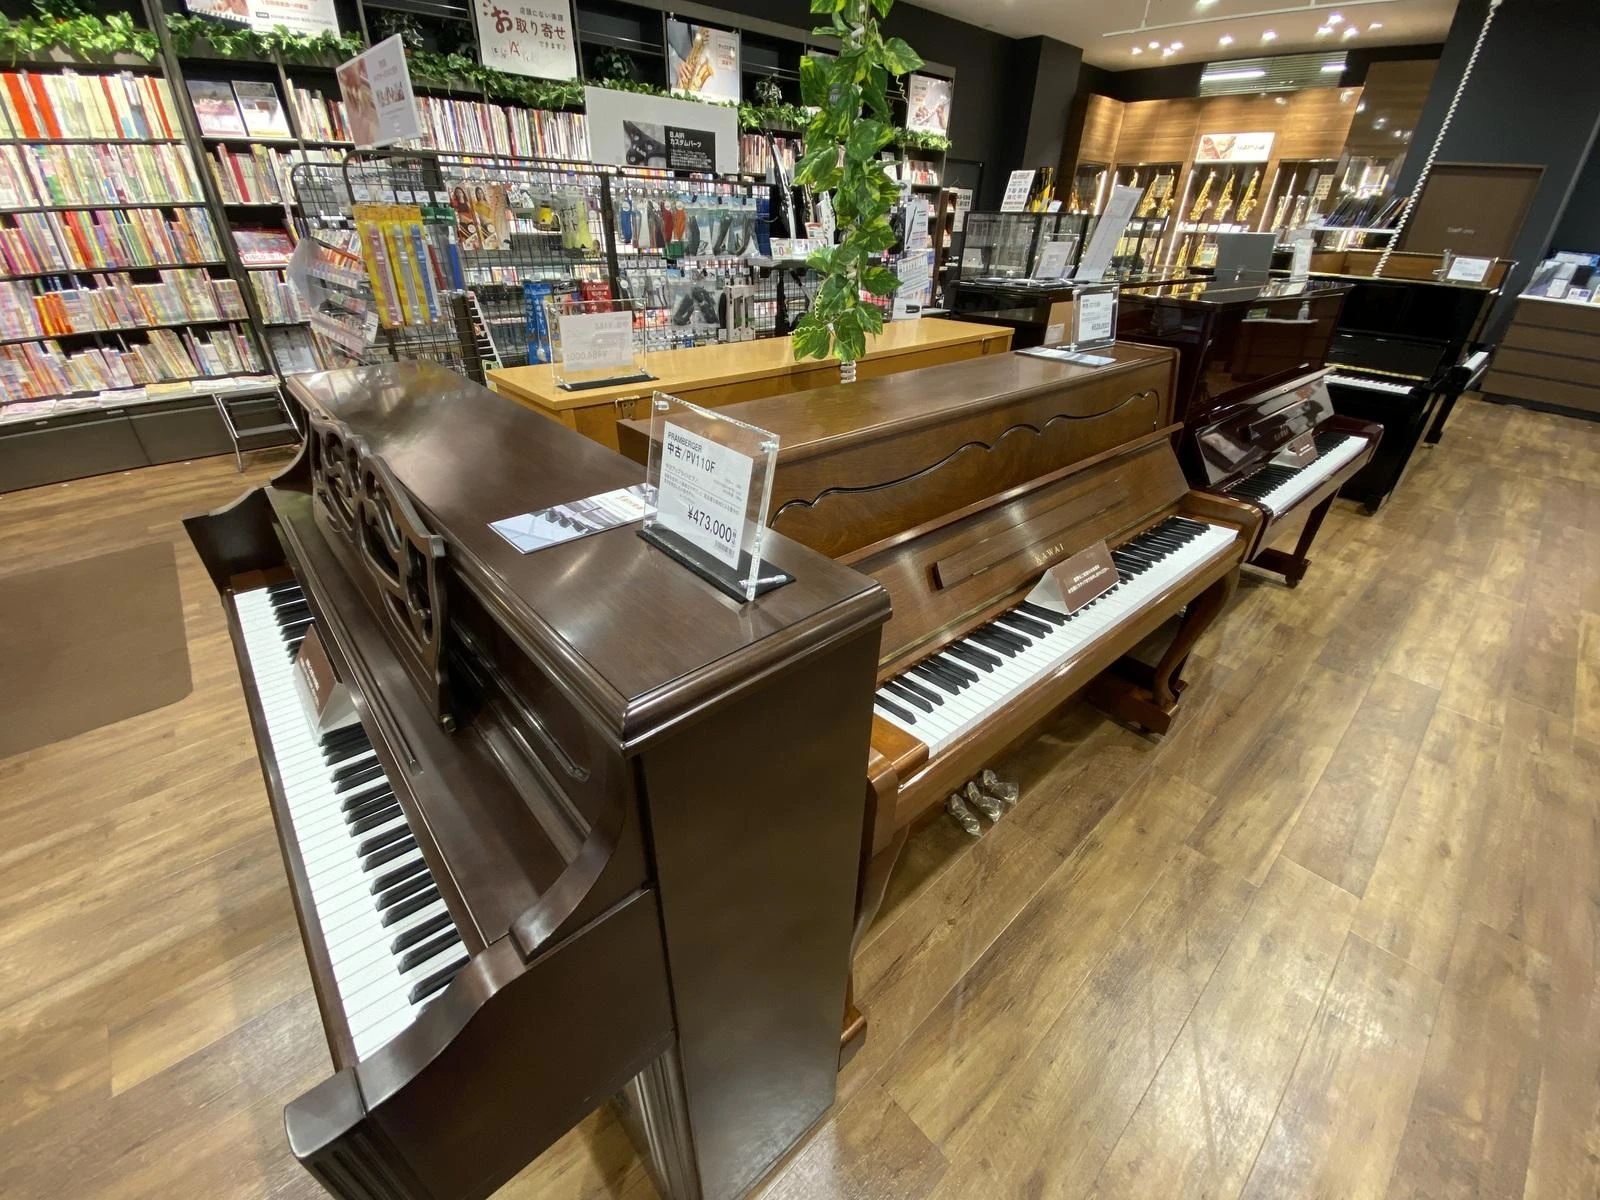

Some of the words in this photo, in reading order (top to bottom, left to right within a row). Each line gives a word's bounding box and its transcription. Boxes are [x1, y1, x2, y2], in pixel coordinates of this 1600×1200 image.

[491, 6, 566, 40] お取り寄せ
[670, 139, 702, 148] カスタムパーツ
[667, 431, 702, 452] PRAMBERGER
[667, 442, 716, 473] 中古/PV110F
[687, 504, 732, 543] ¥473,000
[1033, 543, 1064, 564] KAWAI
